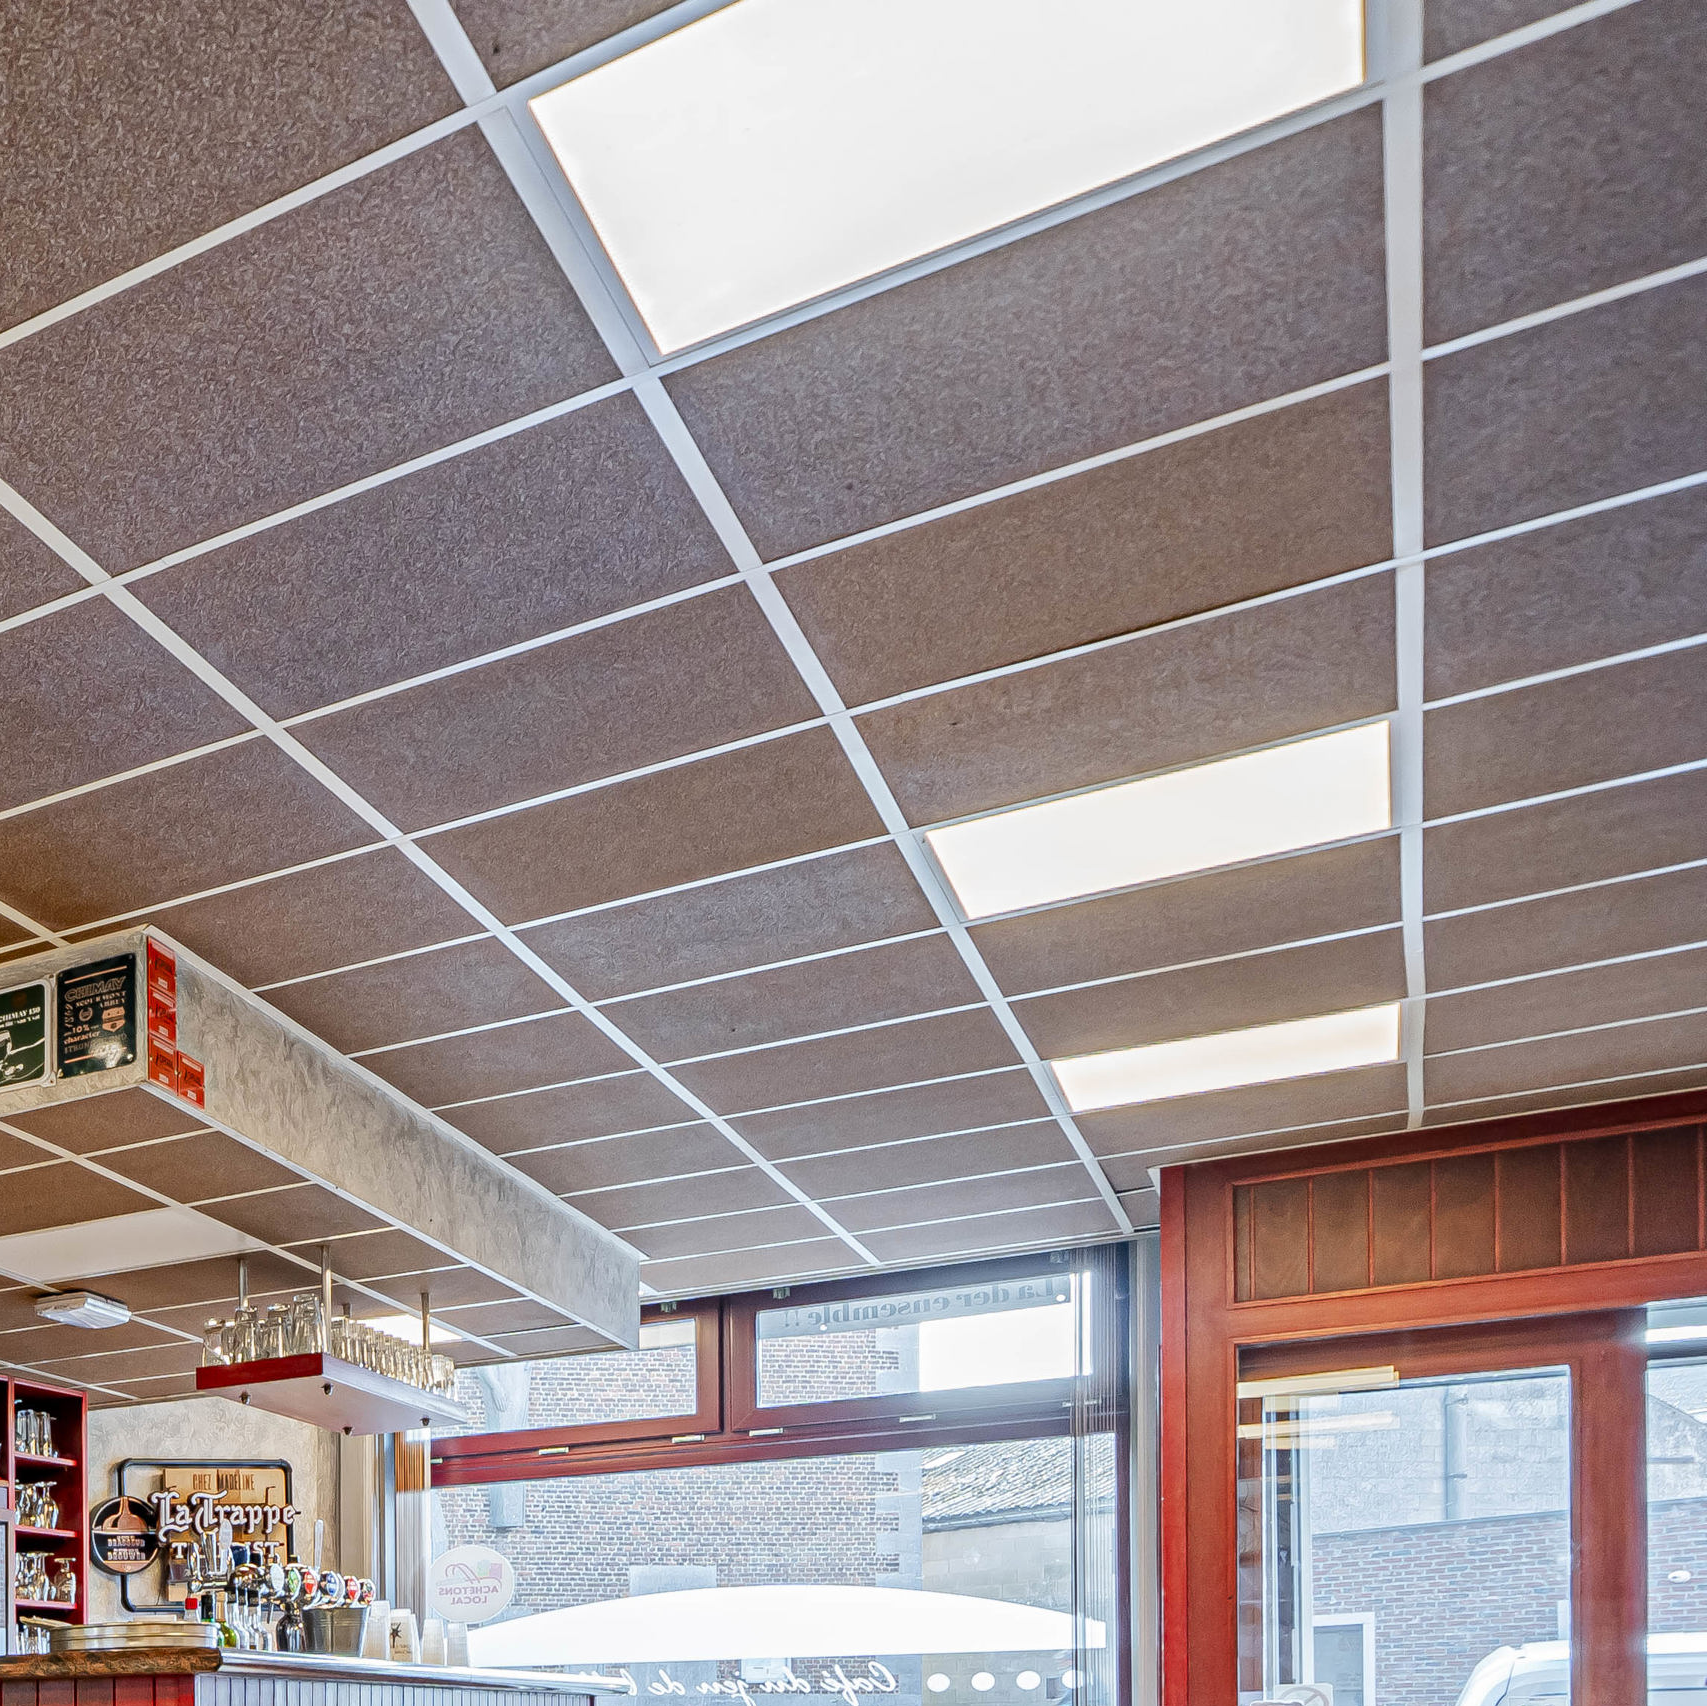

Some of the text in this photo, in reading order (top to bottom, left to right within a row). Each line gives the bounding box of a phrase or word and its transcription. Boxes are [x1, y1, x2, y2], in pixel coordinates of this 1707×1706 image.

[64, 976, 127, 1002] CHIMAY
[28, 1006, 41, 1017] 150
[63, 1030, 101, 1045] character
[192, 1473, 255, 1491] CHEZ MADELINE
[149, 1489, 297, 1542] La Trappe
